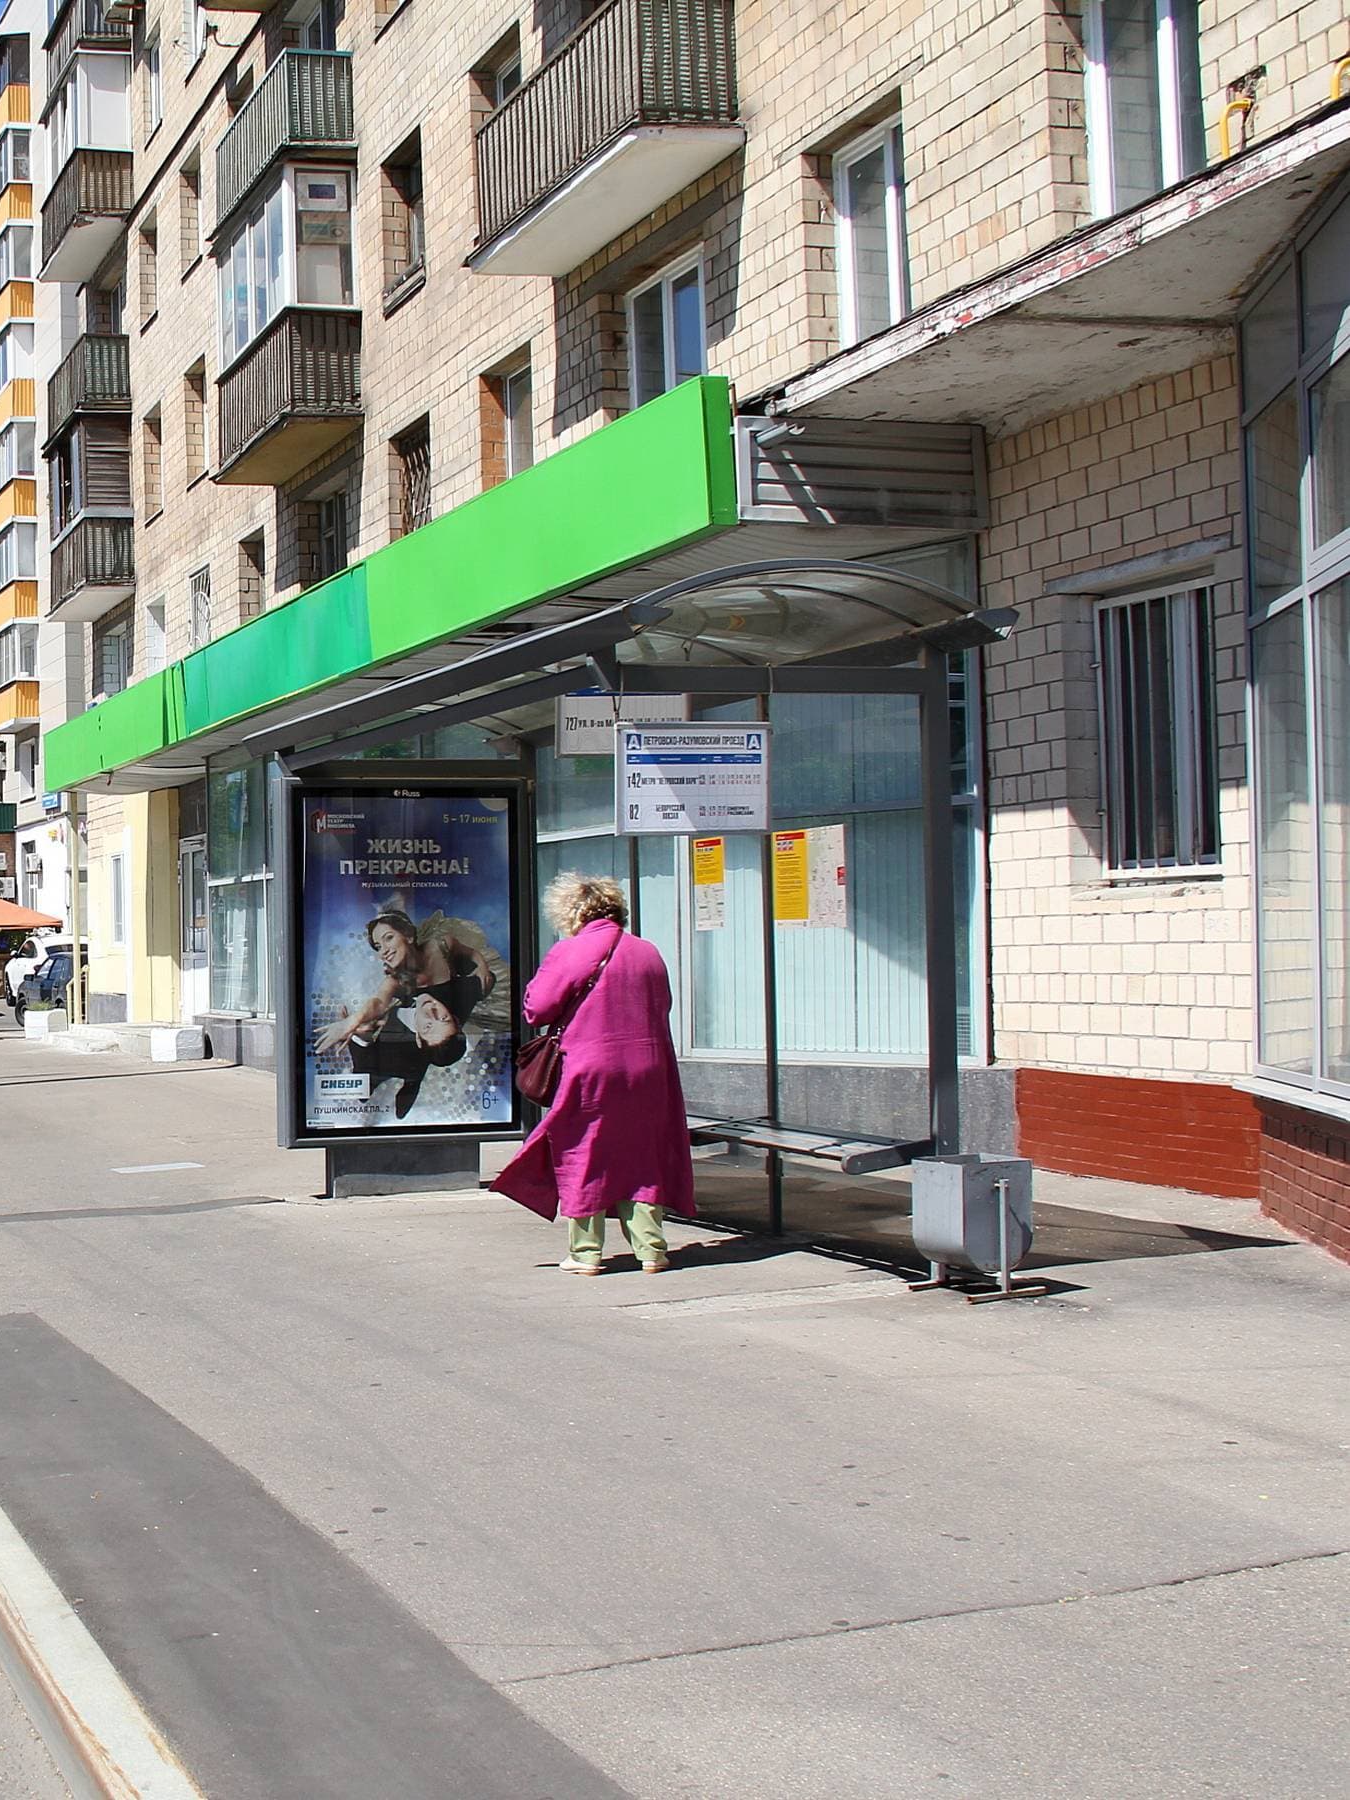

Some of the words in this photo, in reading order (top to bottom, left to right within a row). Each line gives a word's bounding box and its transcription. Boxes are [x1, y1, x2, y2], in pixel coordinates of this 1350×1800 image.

[565, 717, 578, 731] 727
[643, 734, 721, 746] ПЕТРОВСКО-РАЗУМОВСКИЙ
[722, 735, 744, 746] ПРОЕЗД
[443, 814, 450, 823] 5
[459, 814, 469, 823] 17
[472, 816, 498, 824] июня
[367, 838, 441, 854] ЖИЗНЬ
[340, 857, 469, 875] ПРЕКРАСНА!
[321, 1079, 363, 1089] СИБУР
[482, 1091, 499, 1110] 6+
[314, 1105, 369, 1114] ПУШКИНСКАЯ
